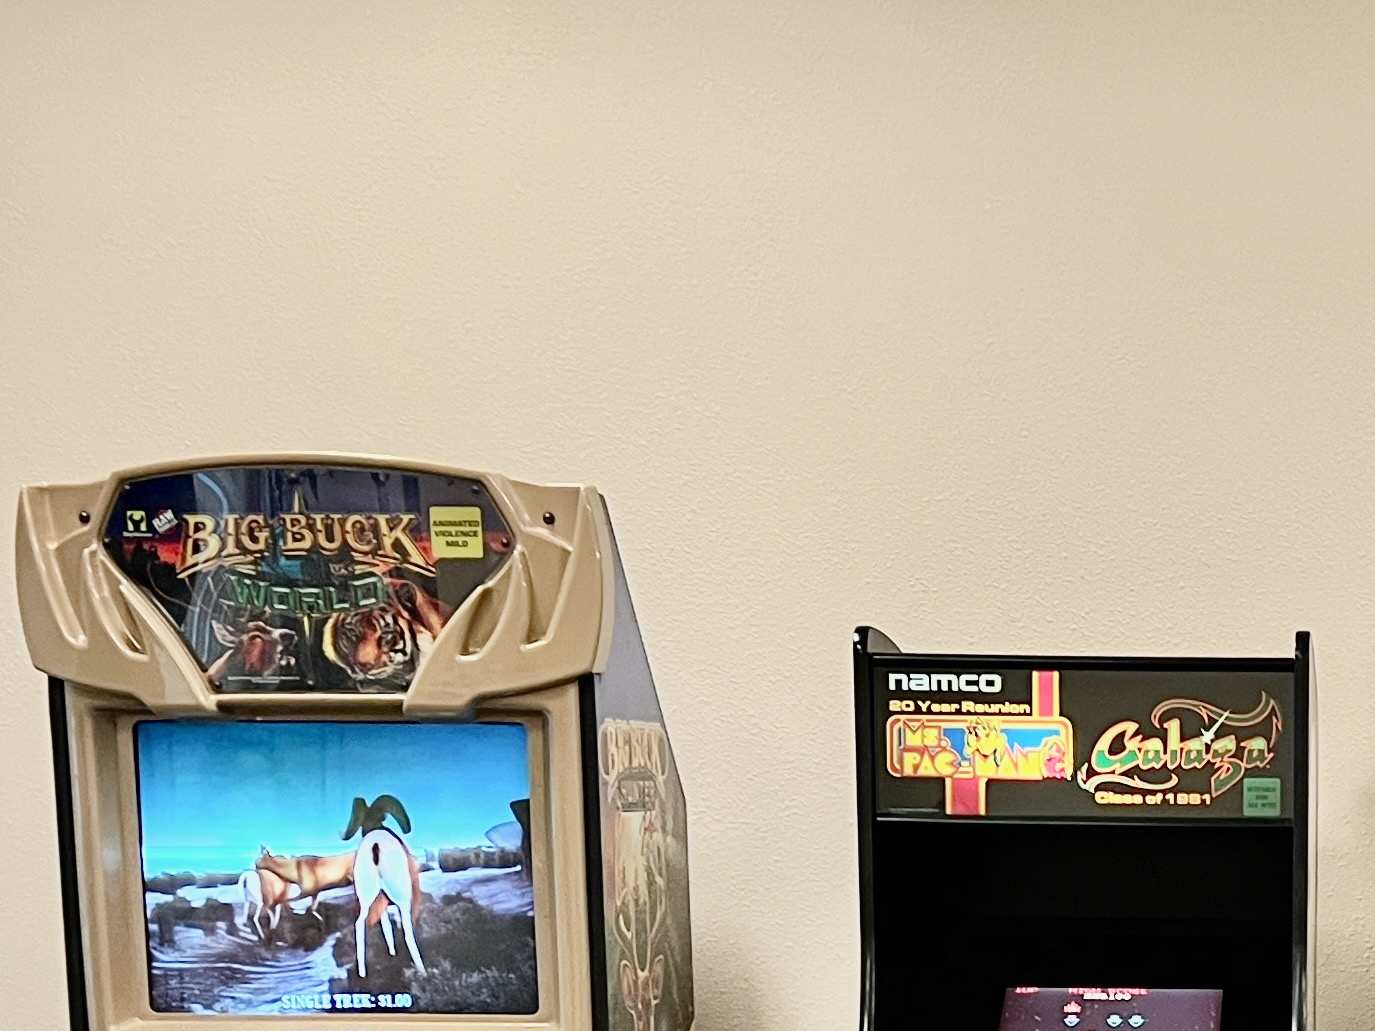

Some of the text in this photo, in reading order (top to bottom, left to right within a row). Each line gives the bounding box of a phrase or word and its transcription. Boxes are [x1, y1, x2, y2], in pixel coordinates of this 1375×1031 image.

[176, 511, 437, 578] BIG BUCK
[224, 572, 386, 614] WORLD
[888, 672, 1003, 693] namco
[888, 699, 1032, 714] 20 Year Reunion
[1094, 790, 1144, 805] Class
[1145, 792, 1164, 805] of
[281, 993, 332, 1009] SINGLE
[333, 992, 377, 1009] TREK:
